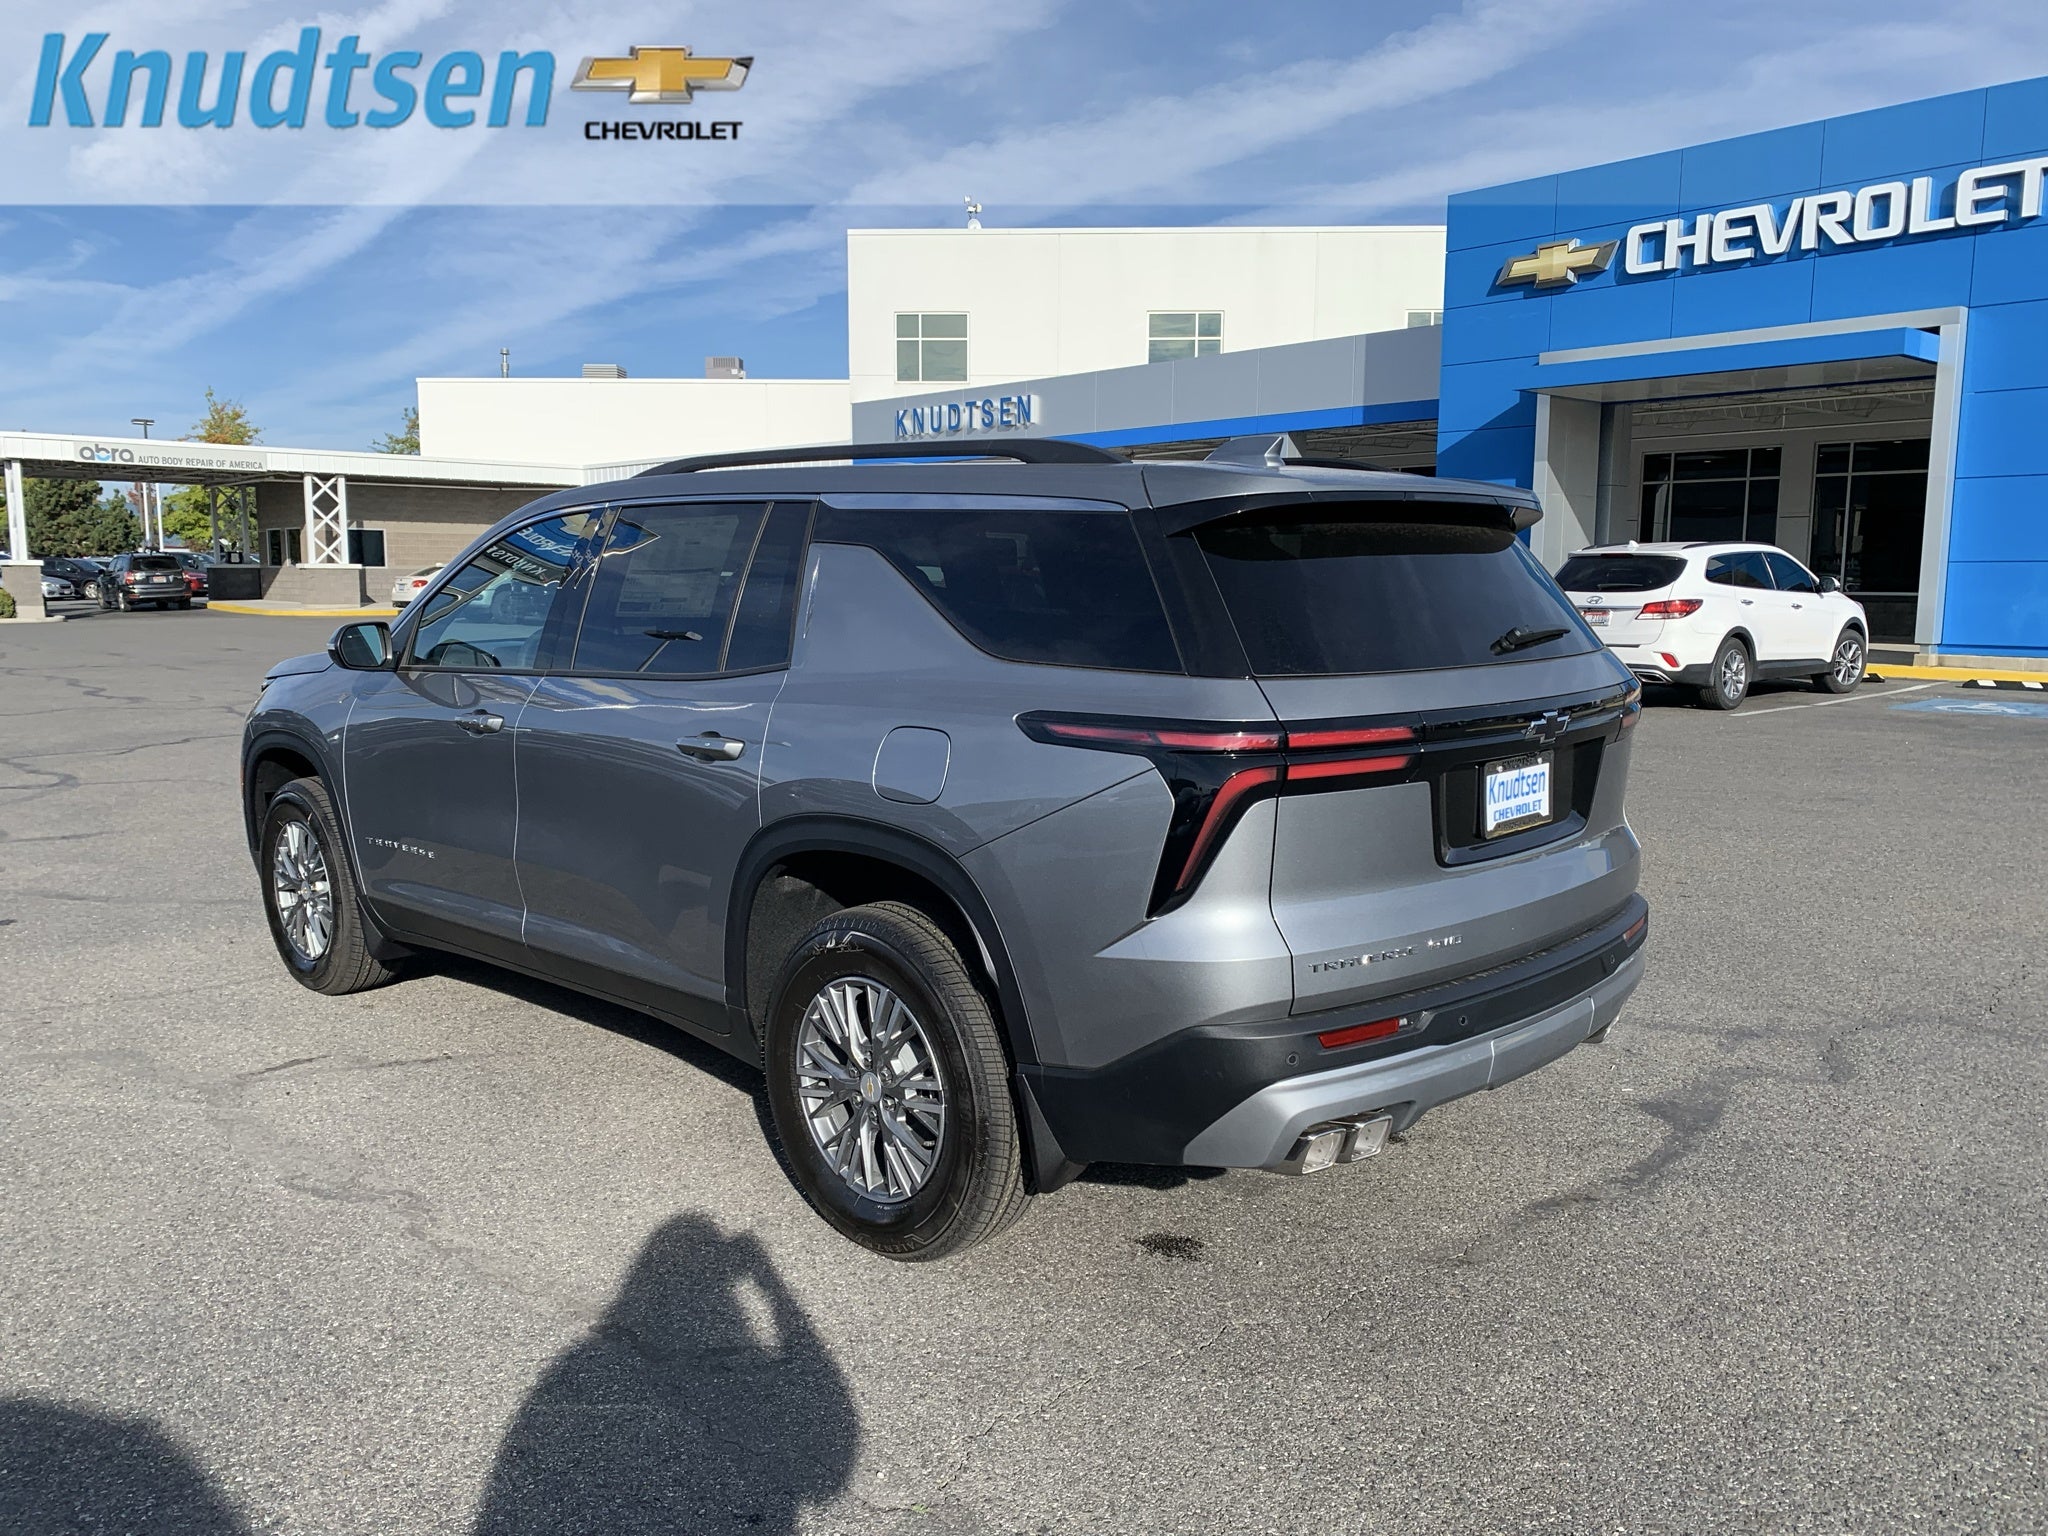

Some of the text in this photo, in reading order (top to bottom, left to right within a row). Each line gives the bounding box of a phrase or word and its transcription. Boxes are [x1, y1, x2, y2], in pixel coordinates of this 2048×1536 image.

[1625, 157, 2048, 275] CHEVROLET
[895, 394, 1036, 437] KNUDTSEN
[79, 443, 263, 470] abra AUTO BODY REPAIR OF AMERICA
[1488, 768, 1545, 805] Knudtsen
[1493, 798, 1543, 822] CHEVROLET
